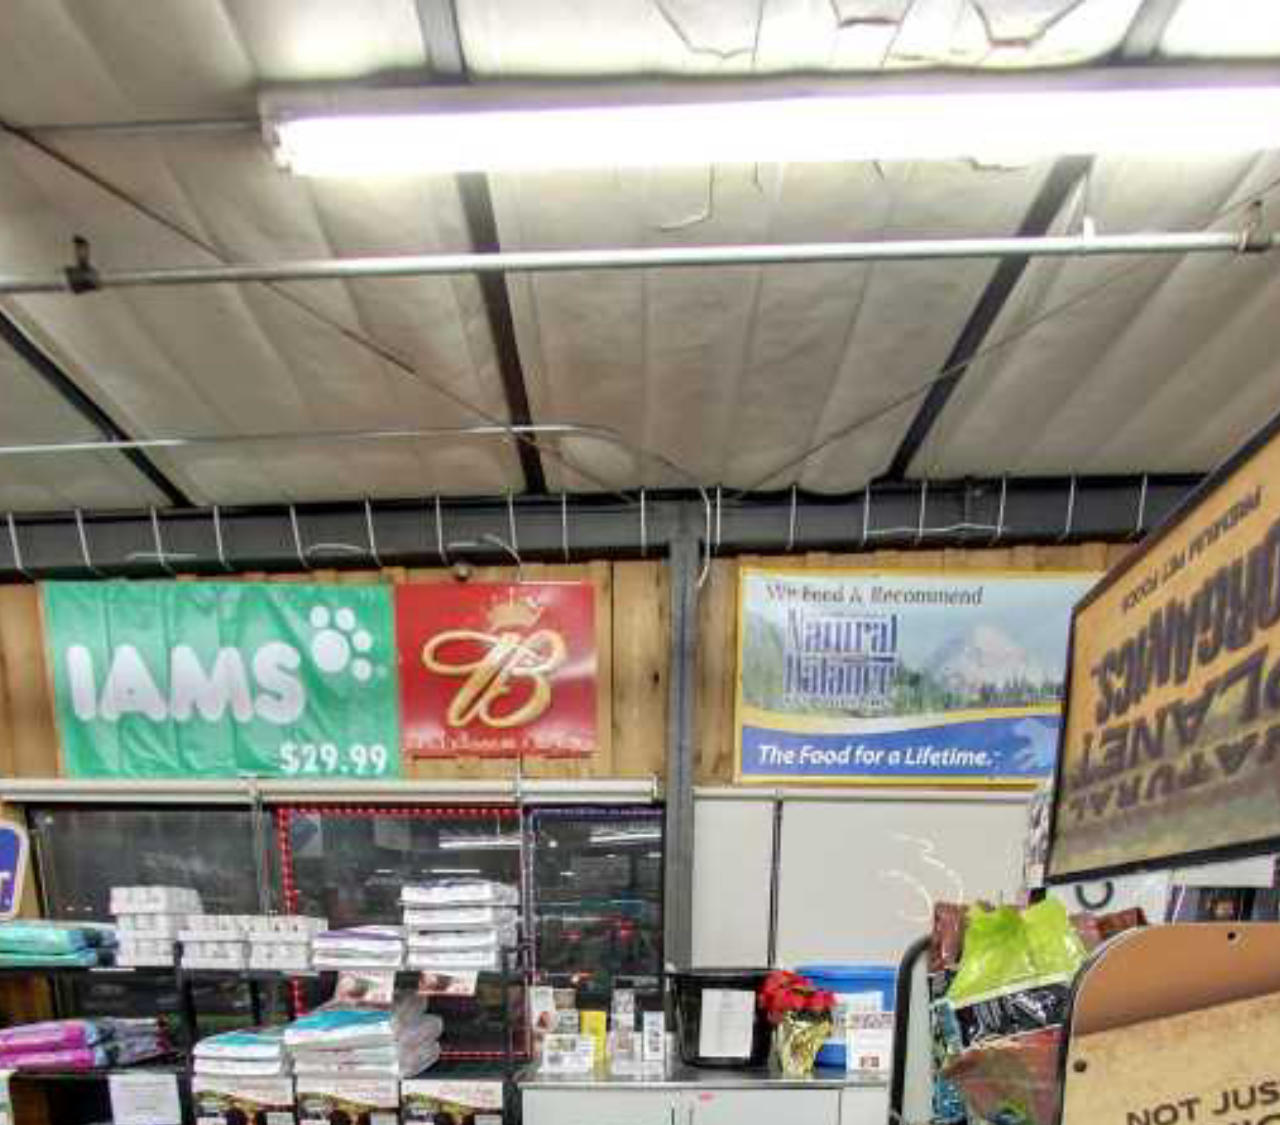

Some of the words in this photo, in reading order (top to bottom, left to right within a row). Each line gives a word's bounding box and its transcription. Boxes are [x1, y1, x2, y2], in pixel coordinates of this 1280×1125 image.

[1187, 486, 1261, 558] PREMIUM
[1161, 544, 1187, 579] PET
[802, 585, 844, 602] Feed
[871, 585, 984, 606] Recommend
[66, 641, 307, 724] IAMS
[278, 743, 388, 775] $29.99
[759, 745, 794, 764] The
[799, 745, 849, 766] Food
[855, 745, 883, 765] for
[888, 751, 901, 765] a
[904, 746, 993, 768] Lifetime.
